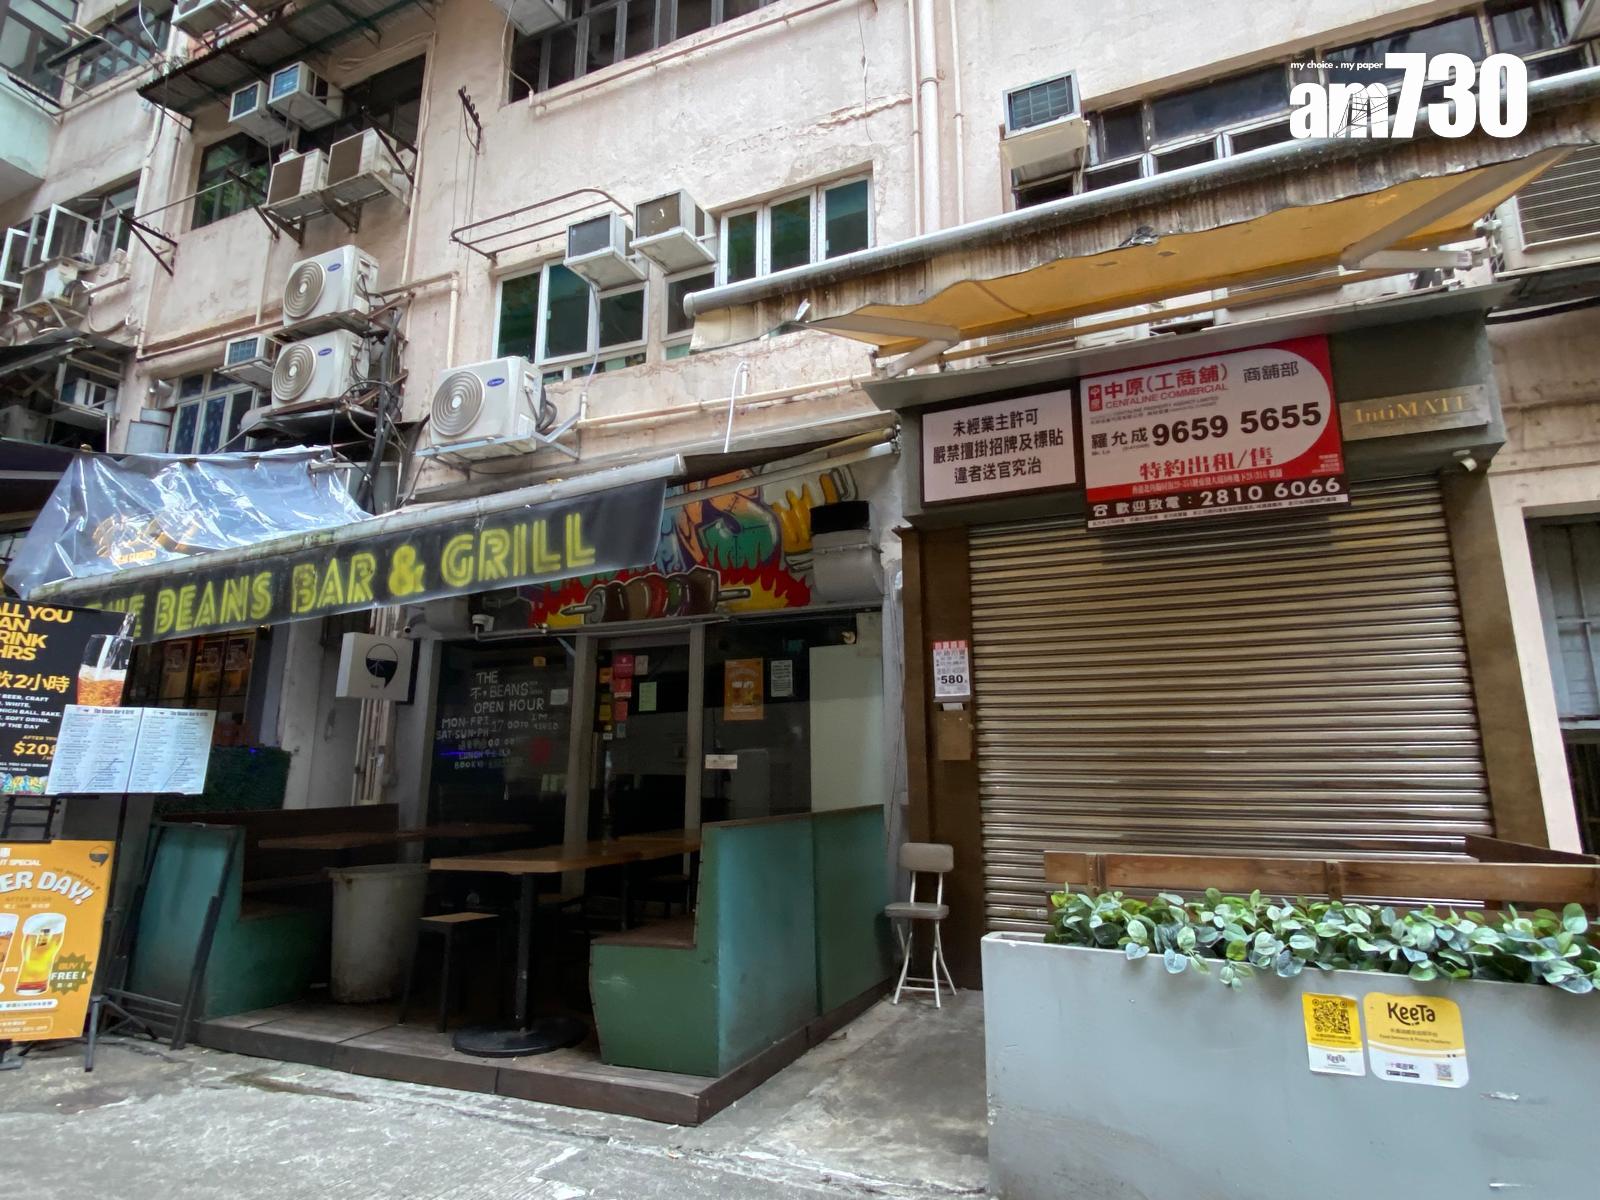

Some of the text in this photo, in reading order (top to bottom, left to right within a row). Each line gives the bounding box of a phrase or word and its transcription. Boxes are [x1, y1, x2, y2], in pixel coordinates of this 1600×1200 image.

[1105, 384, 1228, 409] CENTALINE COMMERCIAL
[952, 408, 1039, 437] 未經業主許可
[1091, 427, 1148, 449] 羅允成
[1152, 415, 1228, 446] 9659
[1240, 402, 1321, 434] 5655
[933, 428, 1064, 464] 嚴禁擅掛招牌及標貼
[954, 456, 1042, 485] 違者送官究治
[1199, 485, 1263, 506] 2810
[1274, 477, 1340, 498] 6066
[154, 571, 272, 634] BEANS
[291, 551, 378, 613] BAR
[387, 544, 426, 596] &
[440, 512, 596, 587] GRILL
[0, 602, 74, 624] LL YOU
[475, 670, 499, 685] THE
[489, 682, 529, 698] BEANS
[940, 674, 964, 685] 580
[474, 698, 545, 714] OPEN HOUR
[0, 871, 94, 905] ER DAY!
[51, 971, 79, 980] FREE
[1387, 1002, 1436, 1026] KeeTa
